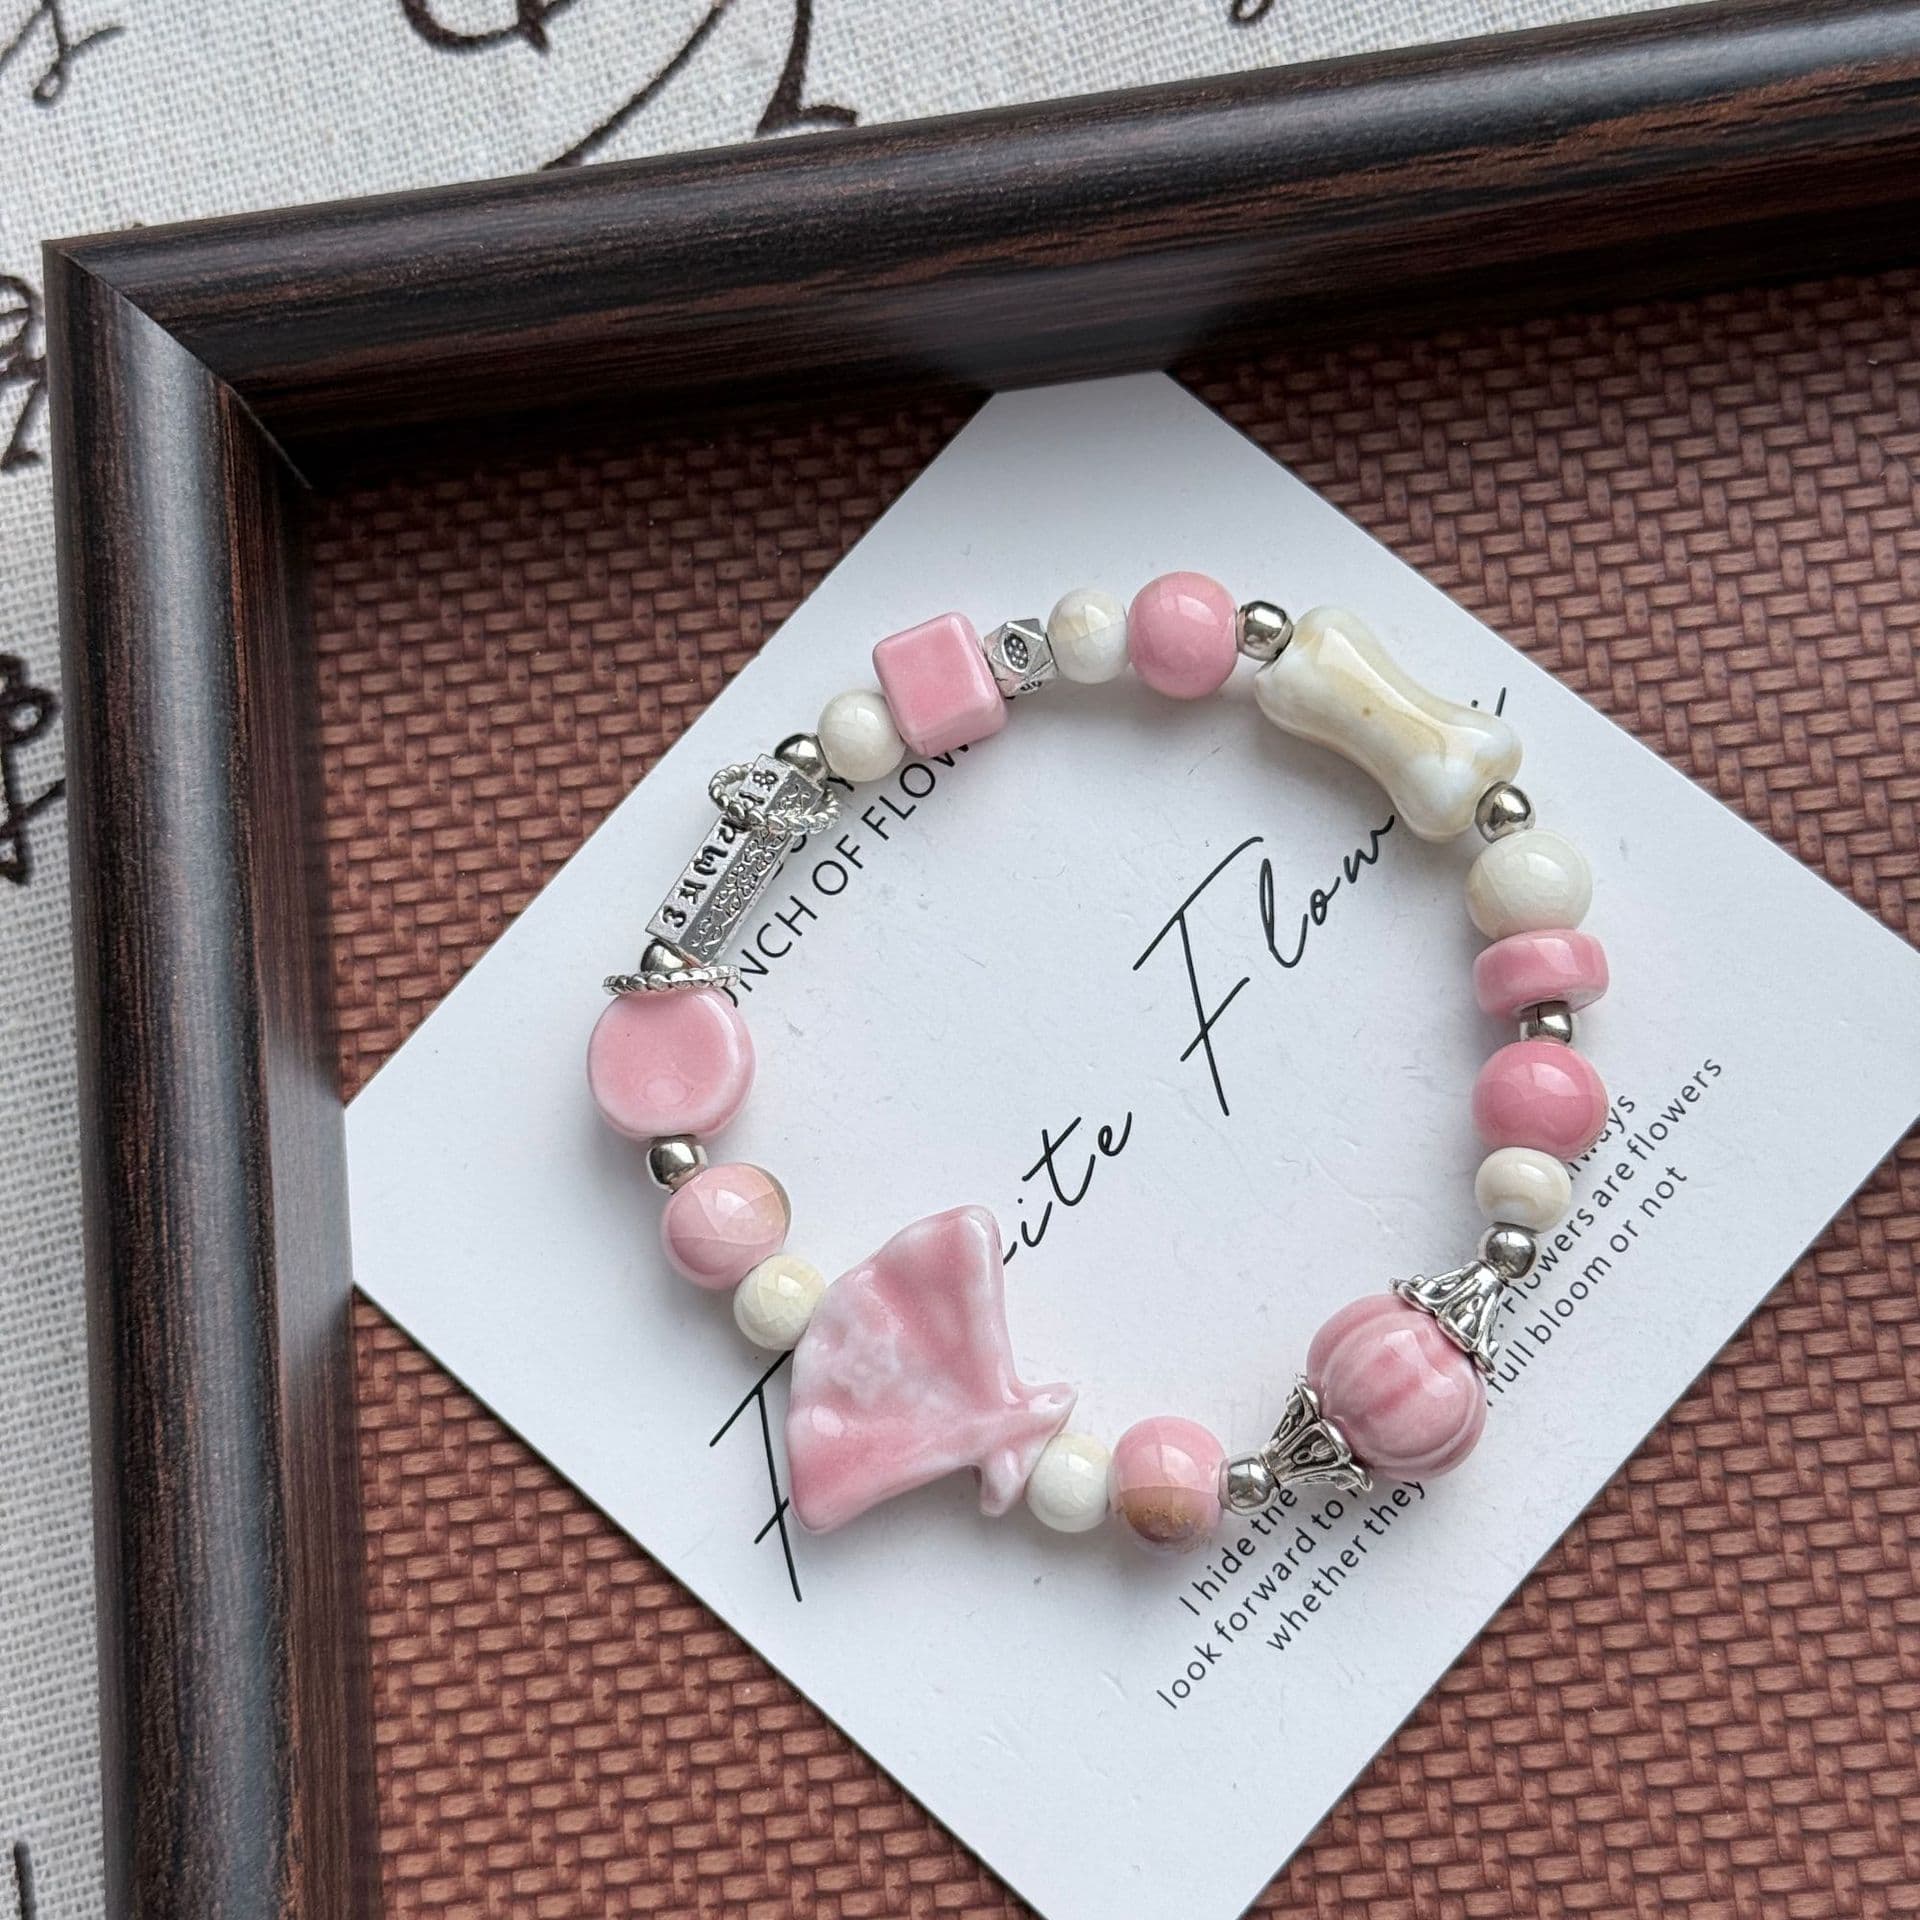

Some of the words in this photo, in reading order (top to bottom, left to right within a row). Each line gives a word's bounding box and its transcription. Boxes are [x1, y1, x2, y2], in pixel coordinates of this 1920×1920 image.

[812, 834, 864, 896] OF
[1156, 1642, 1223, 1710] look
[1214, 1527, 1317, 1643] forward
[1311, 1499, 1344, 1531] to
[1592, 1162, 1635, 1208] are
[1627, 1058, 1722, 1161] flowers
[1266, 1535, 1368, 1651] whether
[1363, 1480, 1426, 1536] they
[1485, 1340, 1535, 1394] full
[1524, 1256, 1612, 1345] bloom
[1609, 1220, 1639, 1253] or
[1638, 1166, 1688, 1218] not
[1179, 1596, 1201, 1616] I
[1191, 1536, 1256, 1602] hide
